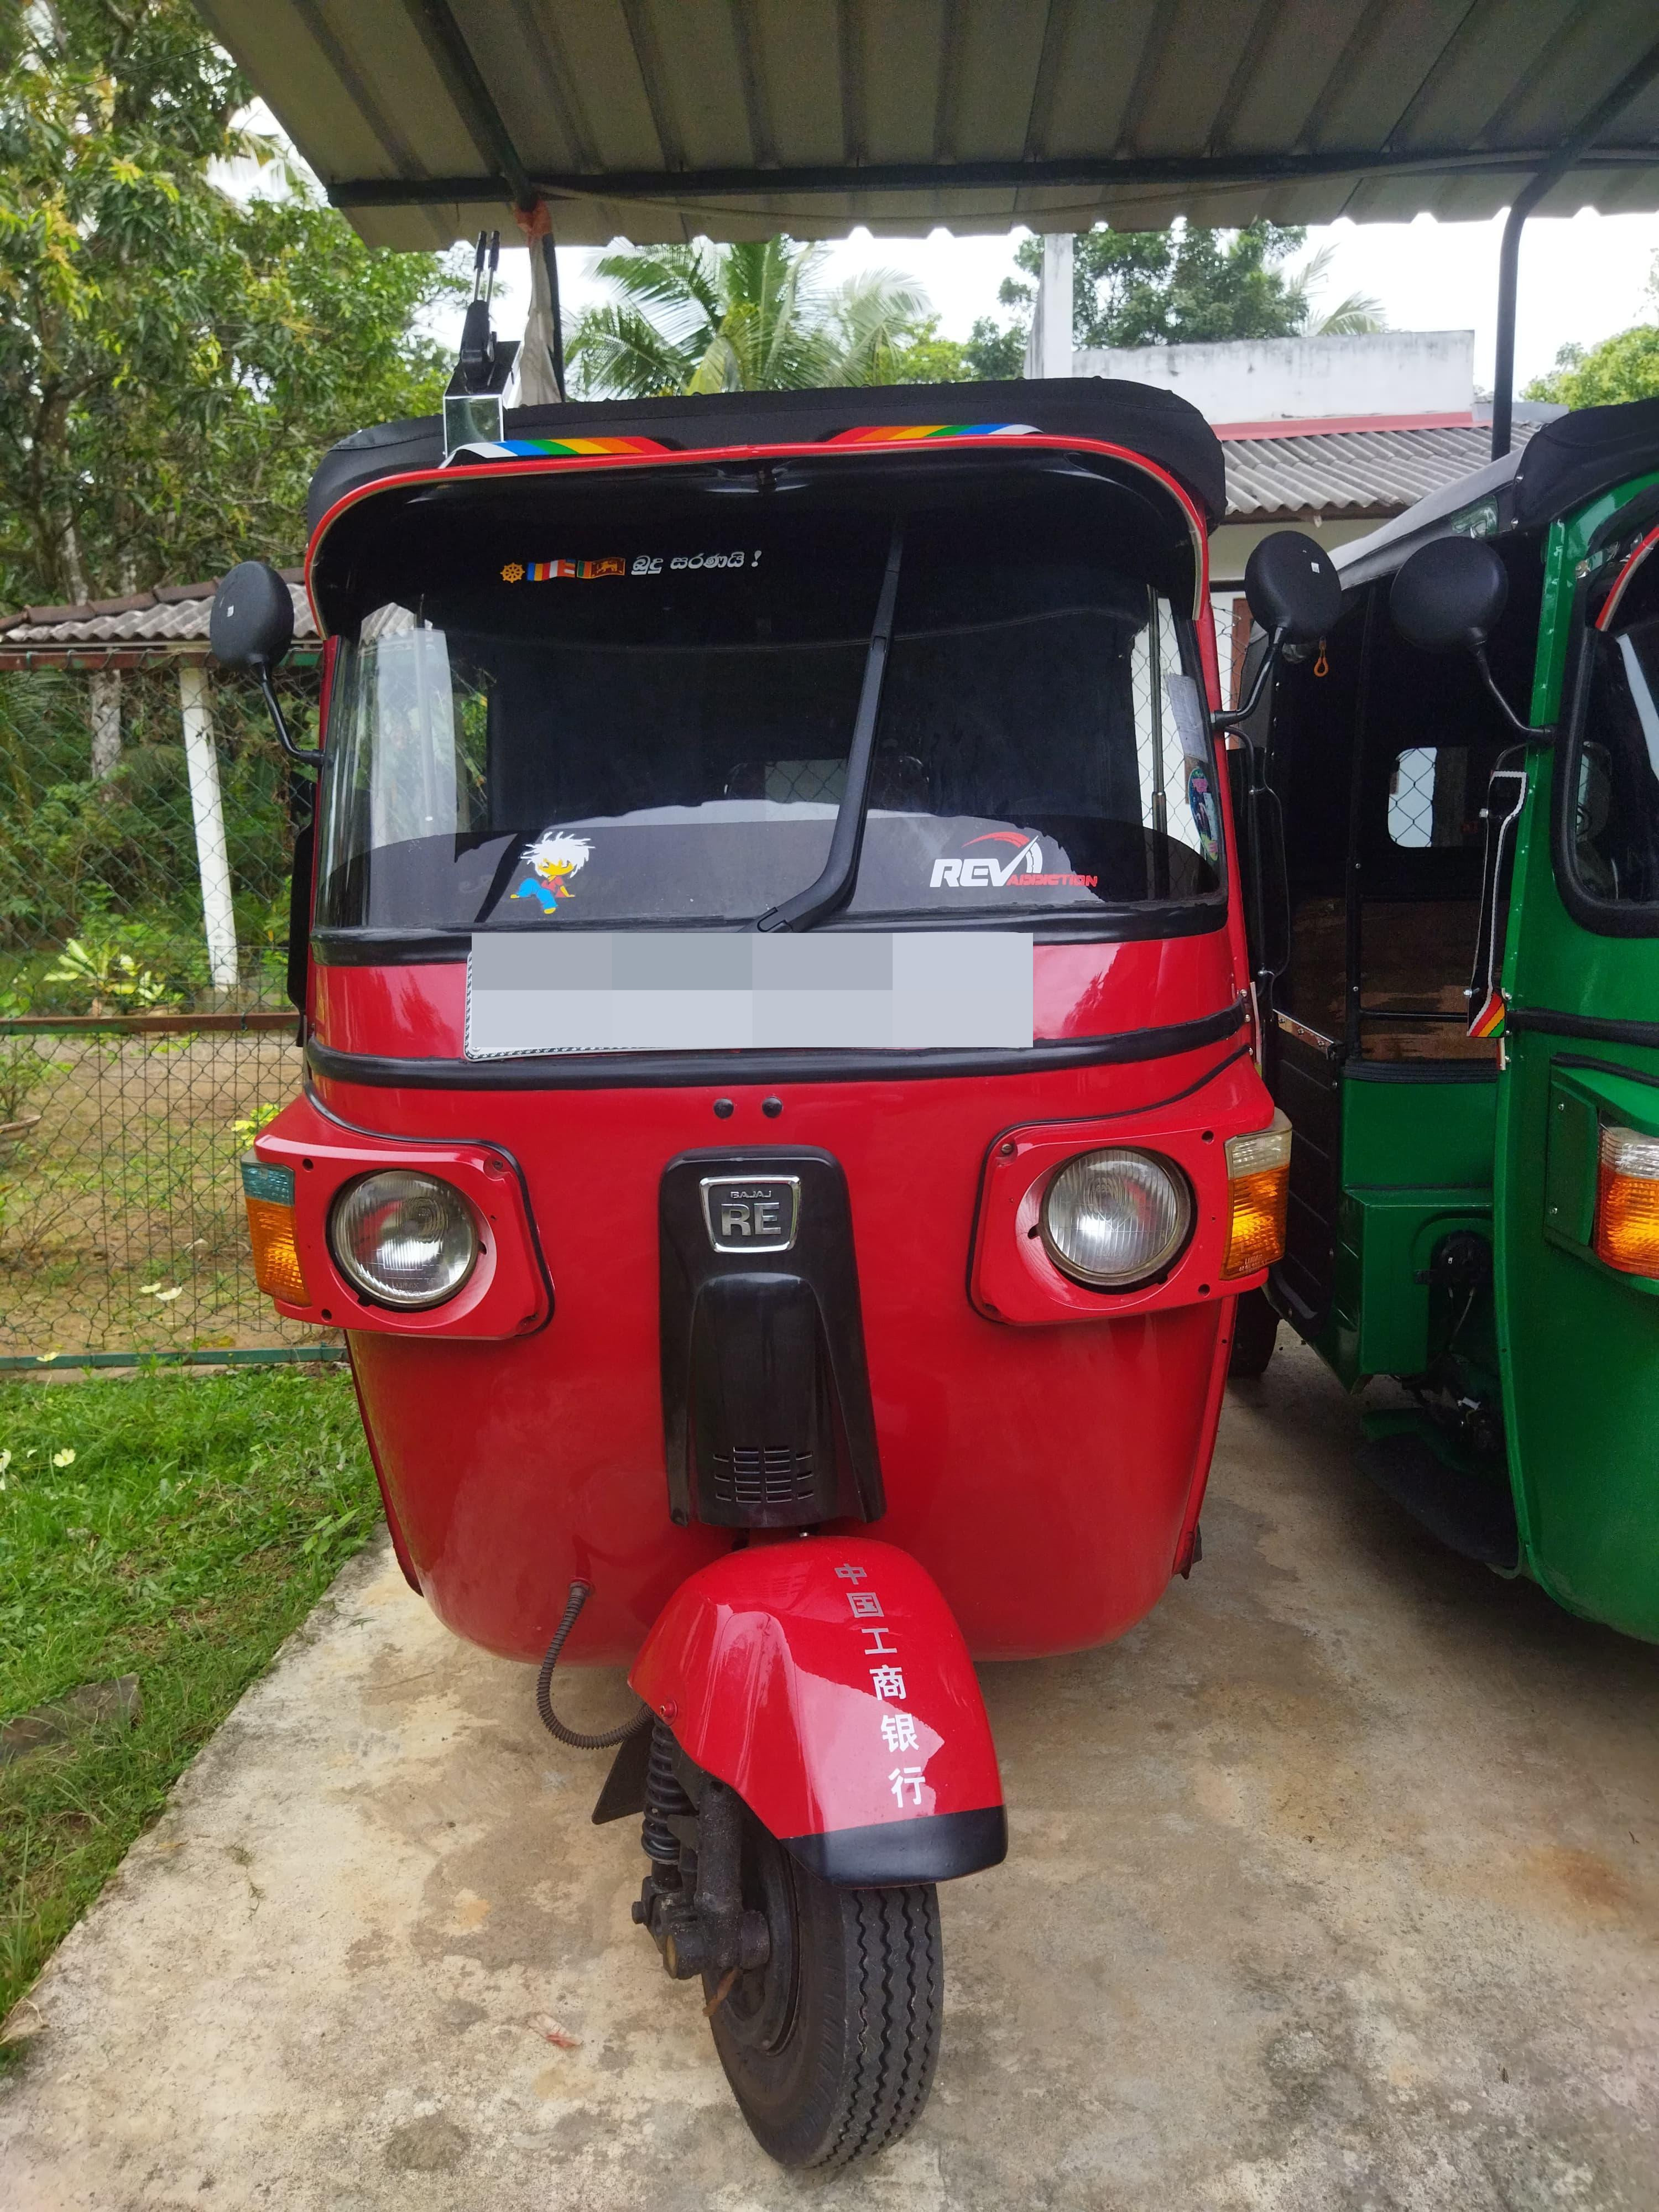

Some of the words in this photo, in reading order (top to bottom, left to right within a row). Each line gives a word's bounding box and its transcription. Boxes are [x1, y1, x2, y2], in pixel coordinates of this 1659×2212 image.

[631, 555, 664, 575] බුදු
[670, 551, 745, 570] සරණයි
[930, 835, 1039, 888] REV
[1005, 874, 1098, 888] ADDICTION
[730, 1190, 772, 1199] BAJAJ
[721, 1202, 782, 1236] RE
[834, 1563, 926, 1808] 中国工商银行
